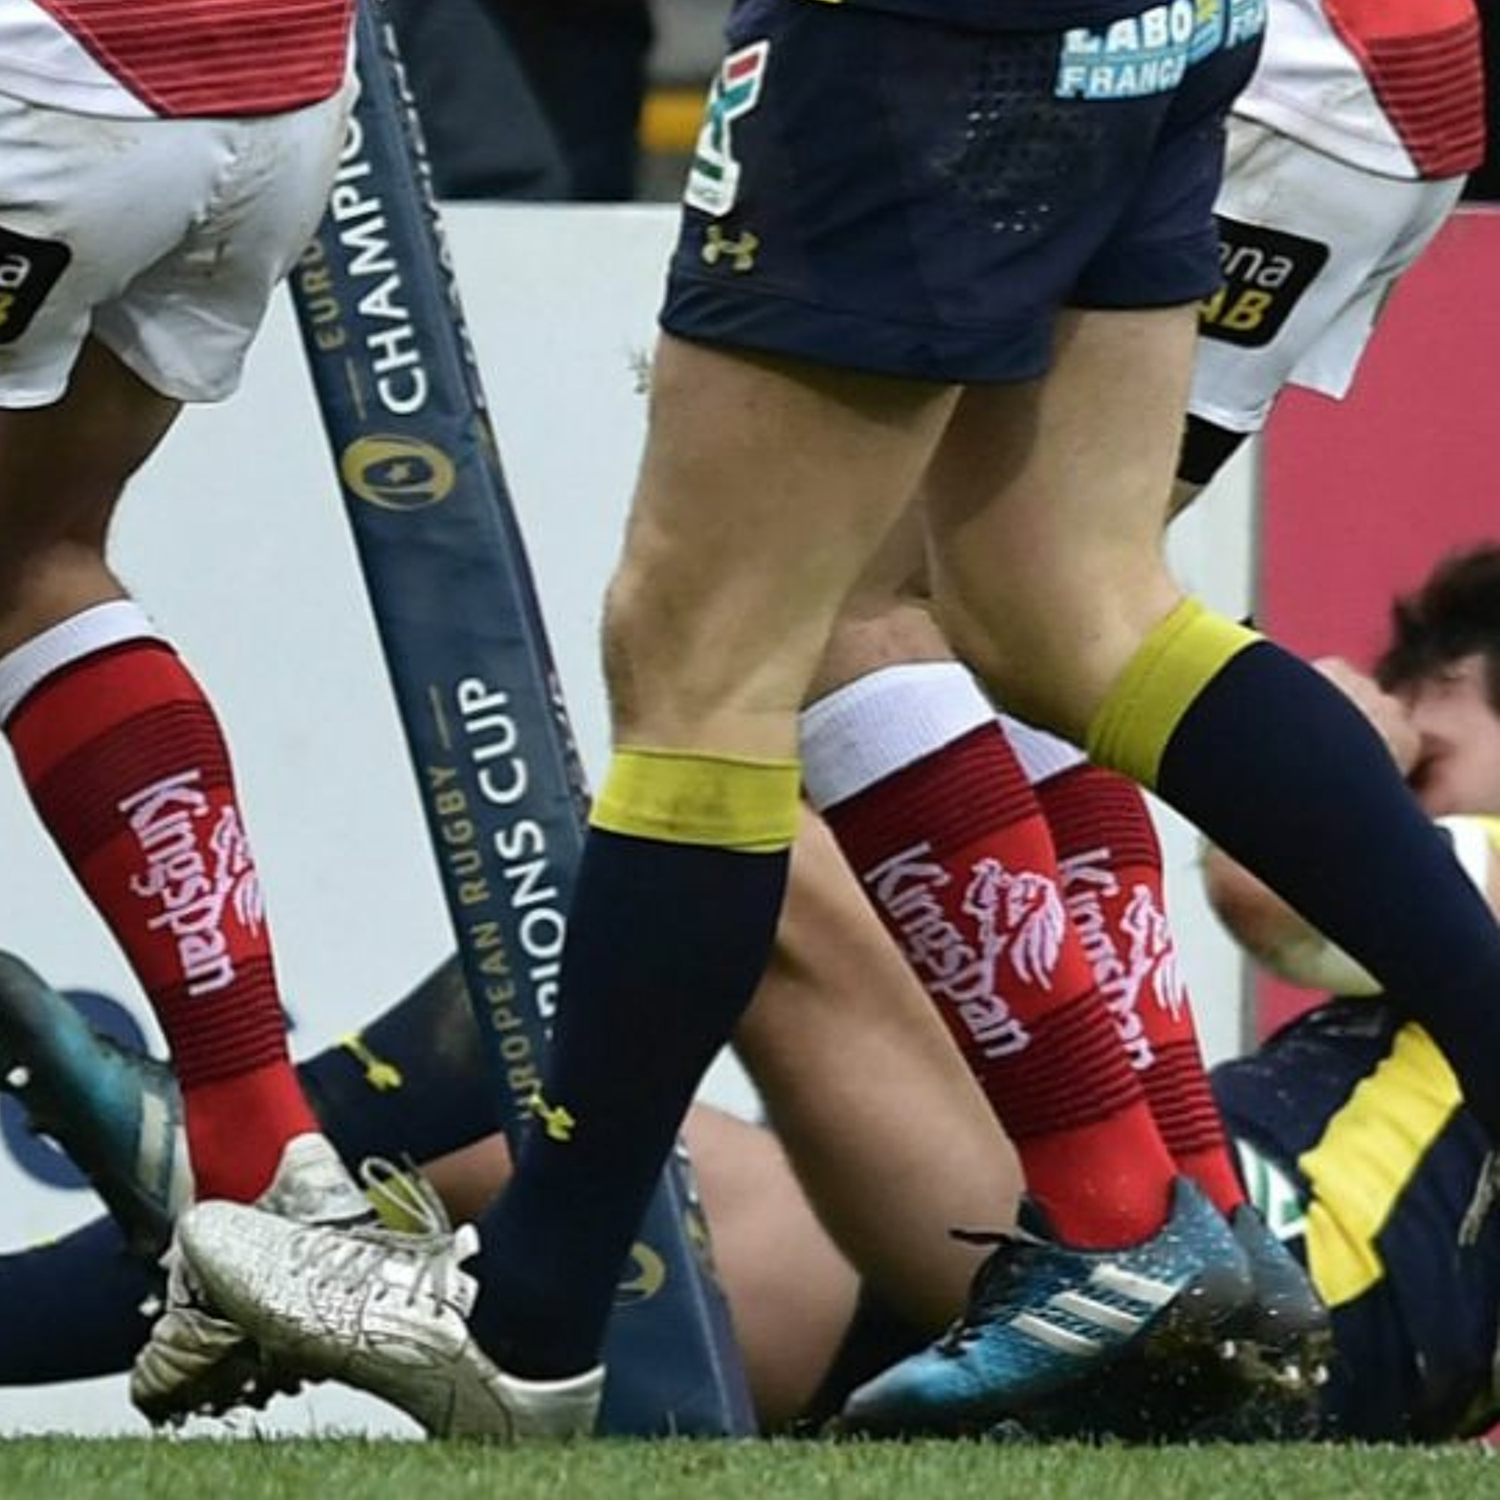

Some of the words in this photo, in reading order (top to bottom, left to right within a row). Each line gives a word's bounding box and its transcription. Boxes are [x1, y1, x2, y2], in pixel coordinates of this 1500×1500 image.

[456, 676, 529, 805] CUP
[116, 768, 237, 996] Kingspan
[429, 764, 492, 906] RUGBY
[862, 840, 1033, 1060] Kingspan
